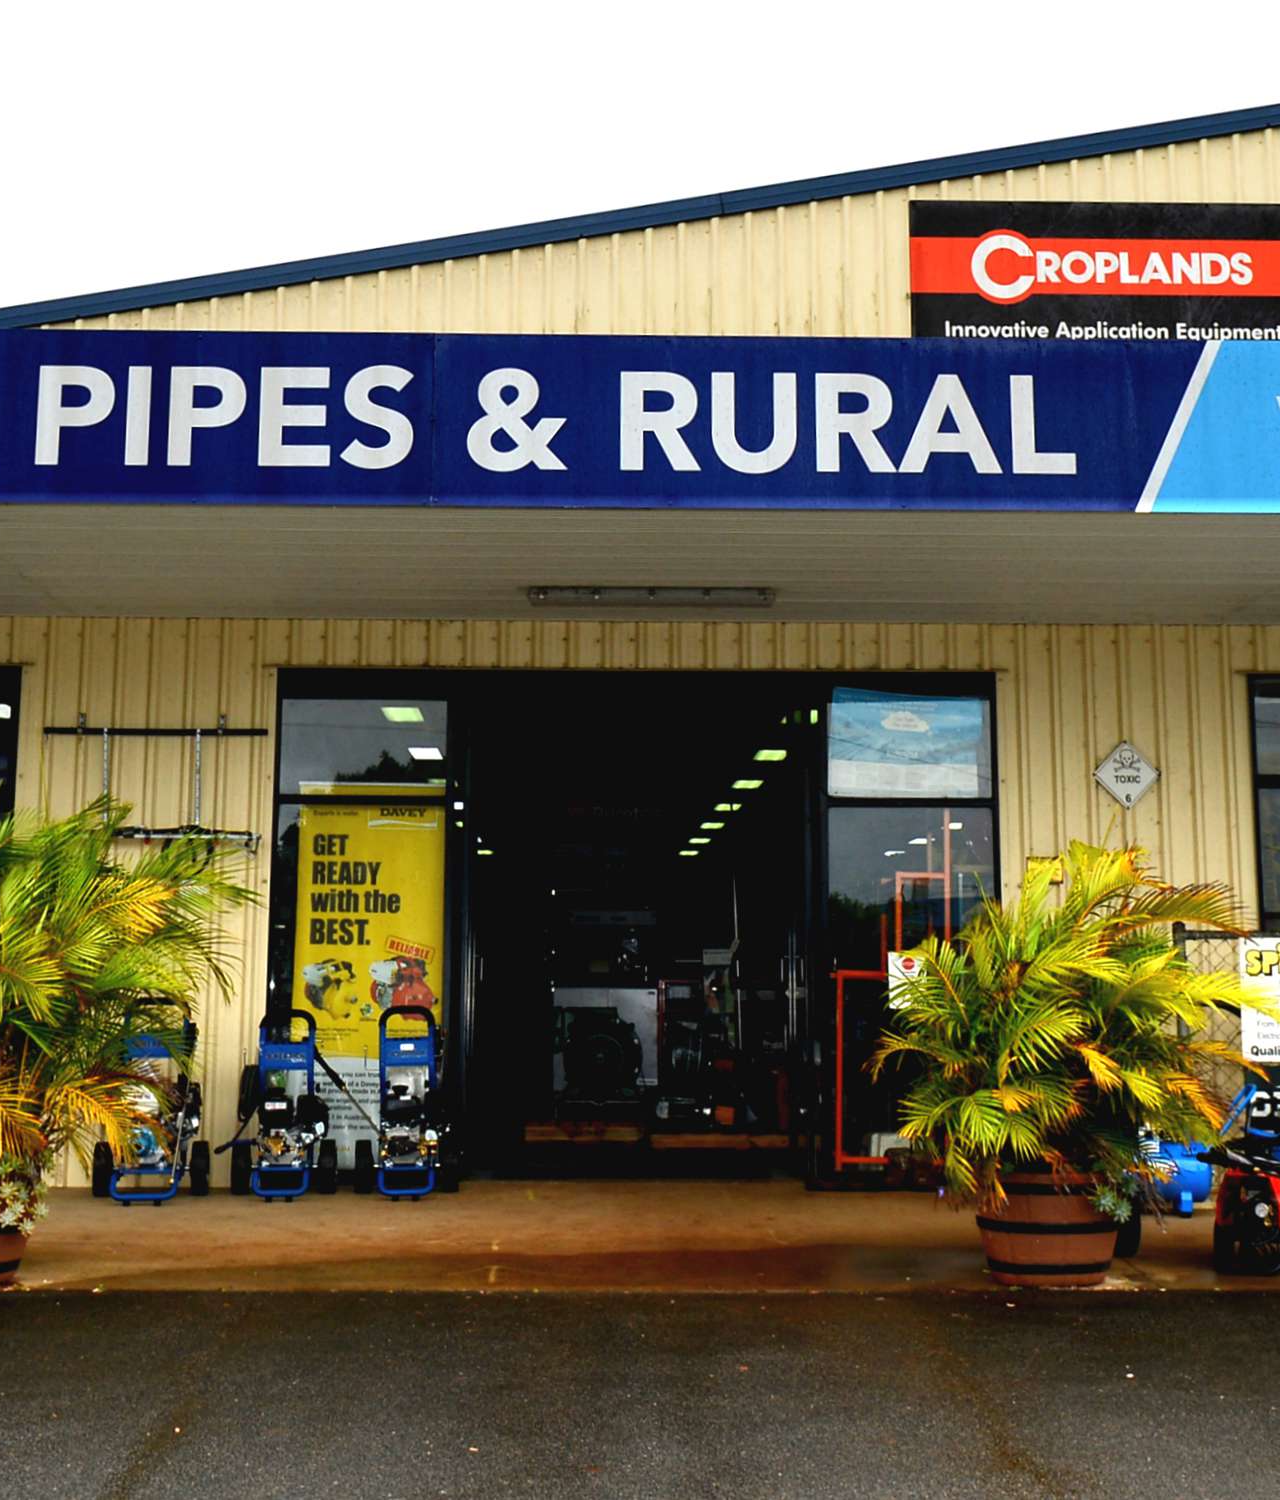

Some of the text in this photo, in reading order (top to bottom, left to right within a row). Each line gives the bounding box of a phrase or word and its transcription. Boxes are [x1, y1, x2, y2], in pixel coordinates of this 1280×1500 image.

[971, 234, 1253, 298] CROPLANDS
[945, 320, 1049, 339] Innovative
[1056, 321, 1169, 340] Application
[34, 365, 414, 469] PIPES
[466, 367, 568, 472] &
[620, 371, 1076, 475] RURAL
[1114, 775, 1141, 784] TOXIC
[1125, 793, 1132, 803] 6
[380, 808, 427, 818] DAVEY
[313, 833, 349, 856] GET
[312, 861, 382, 886] READY
[311, 889, 401, 913] with the
[310, 918, 371, 945] BEST.
[388, 939, 431, 960] RELIABLE
